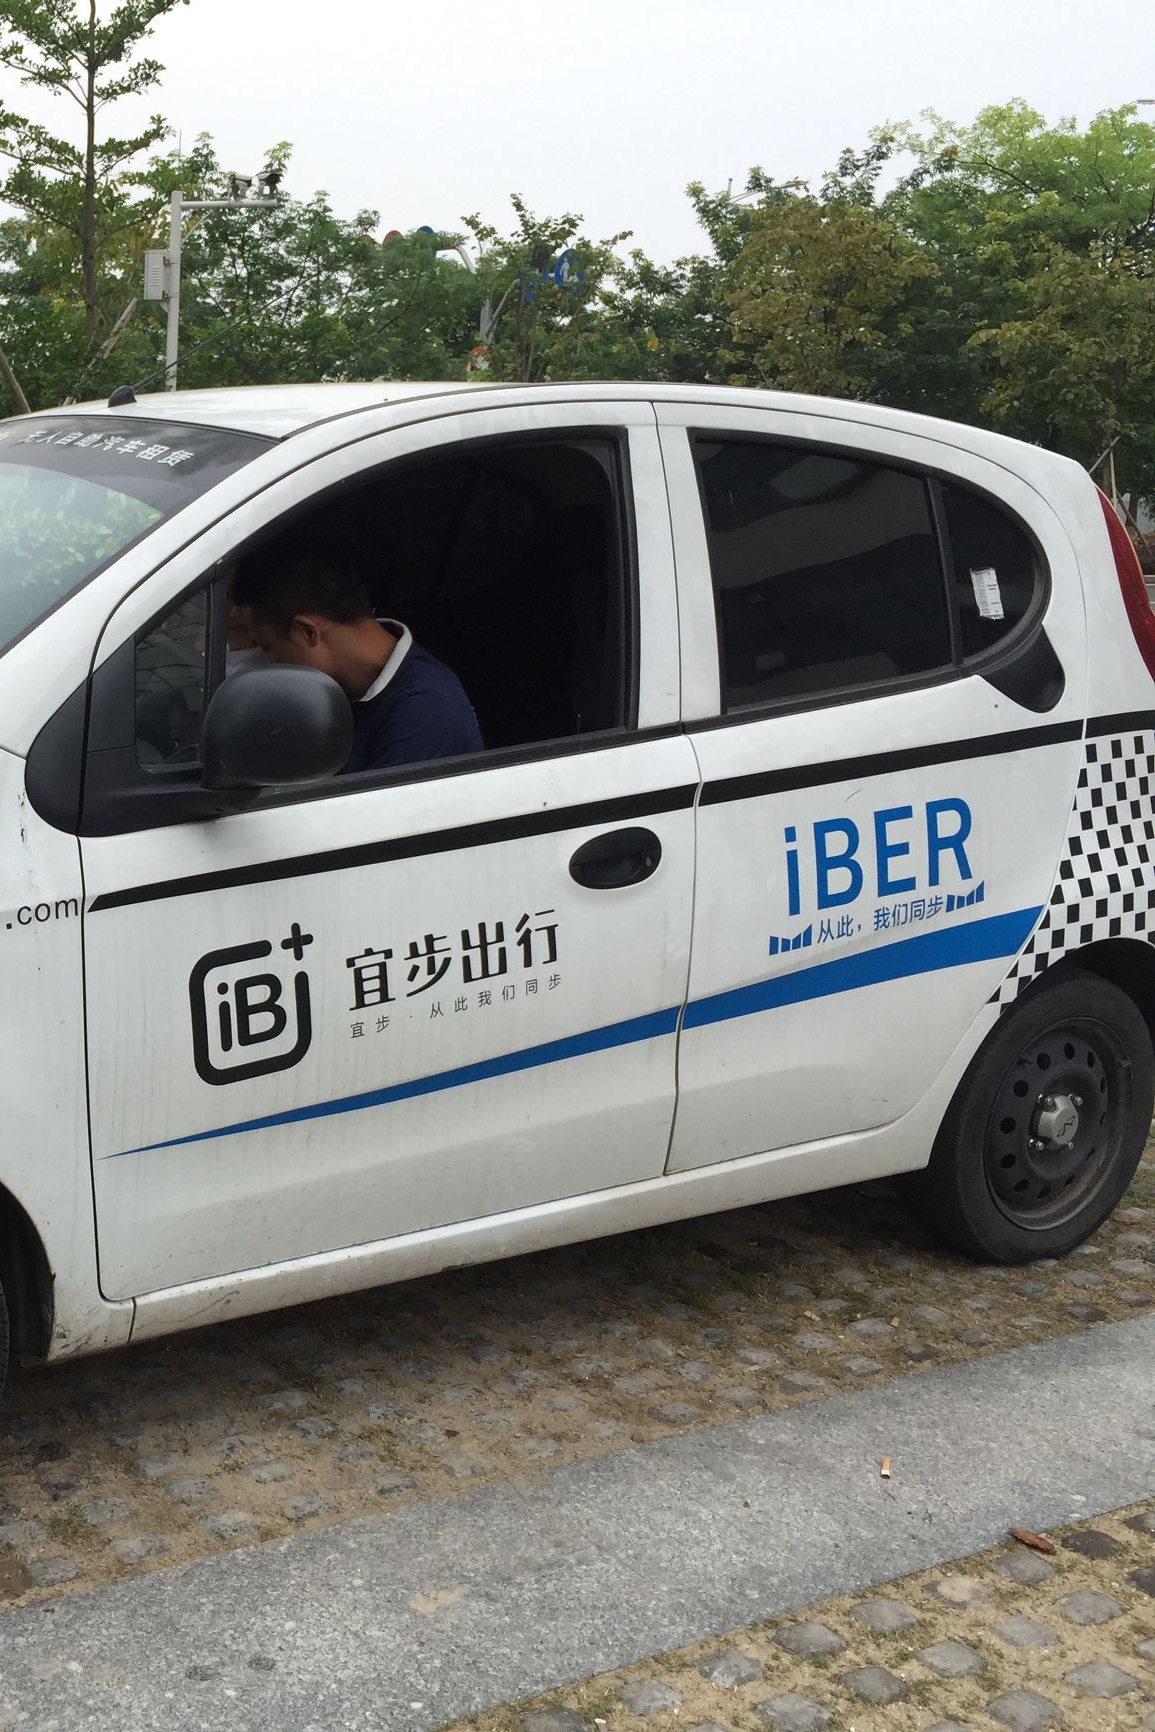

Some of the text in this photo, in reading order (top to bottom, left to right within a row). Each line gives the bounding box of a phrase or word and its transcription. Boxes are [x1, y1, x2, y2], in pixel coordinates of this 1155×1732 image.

[784, 797, 973, 917] iBER
[346, 909, 560, 1011] 宜步出行
[817, 894, 944, 944] 从此，我们同步
